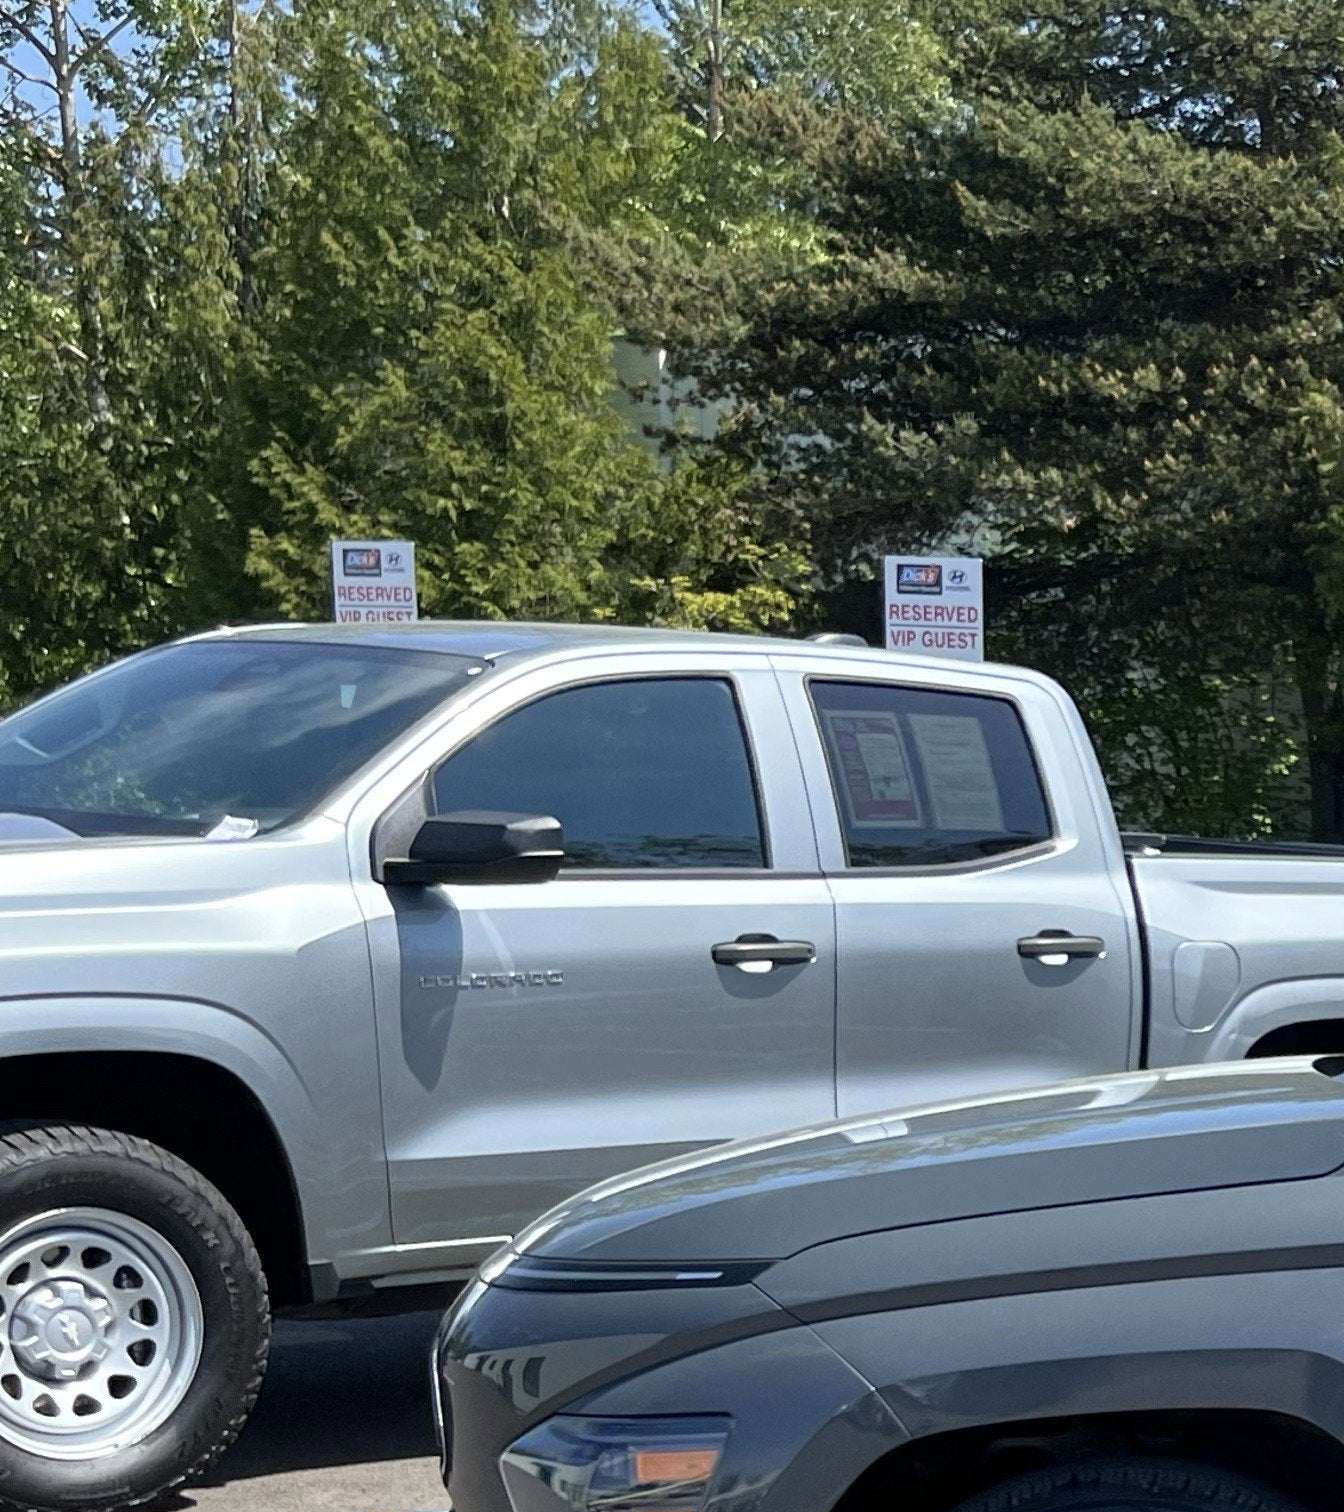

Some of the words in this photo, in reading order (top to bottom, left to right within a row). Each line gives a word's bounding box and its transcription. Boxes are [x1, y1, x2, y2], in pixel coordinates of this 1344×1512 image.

[337, 585, 414, 603] RESERVED
[889, 603, 979, 624] RESERVED
[890, 629, 916, 648] VIP
[921, 630, 979, 650] GUEST
